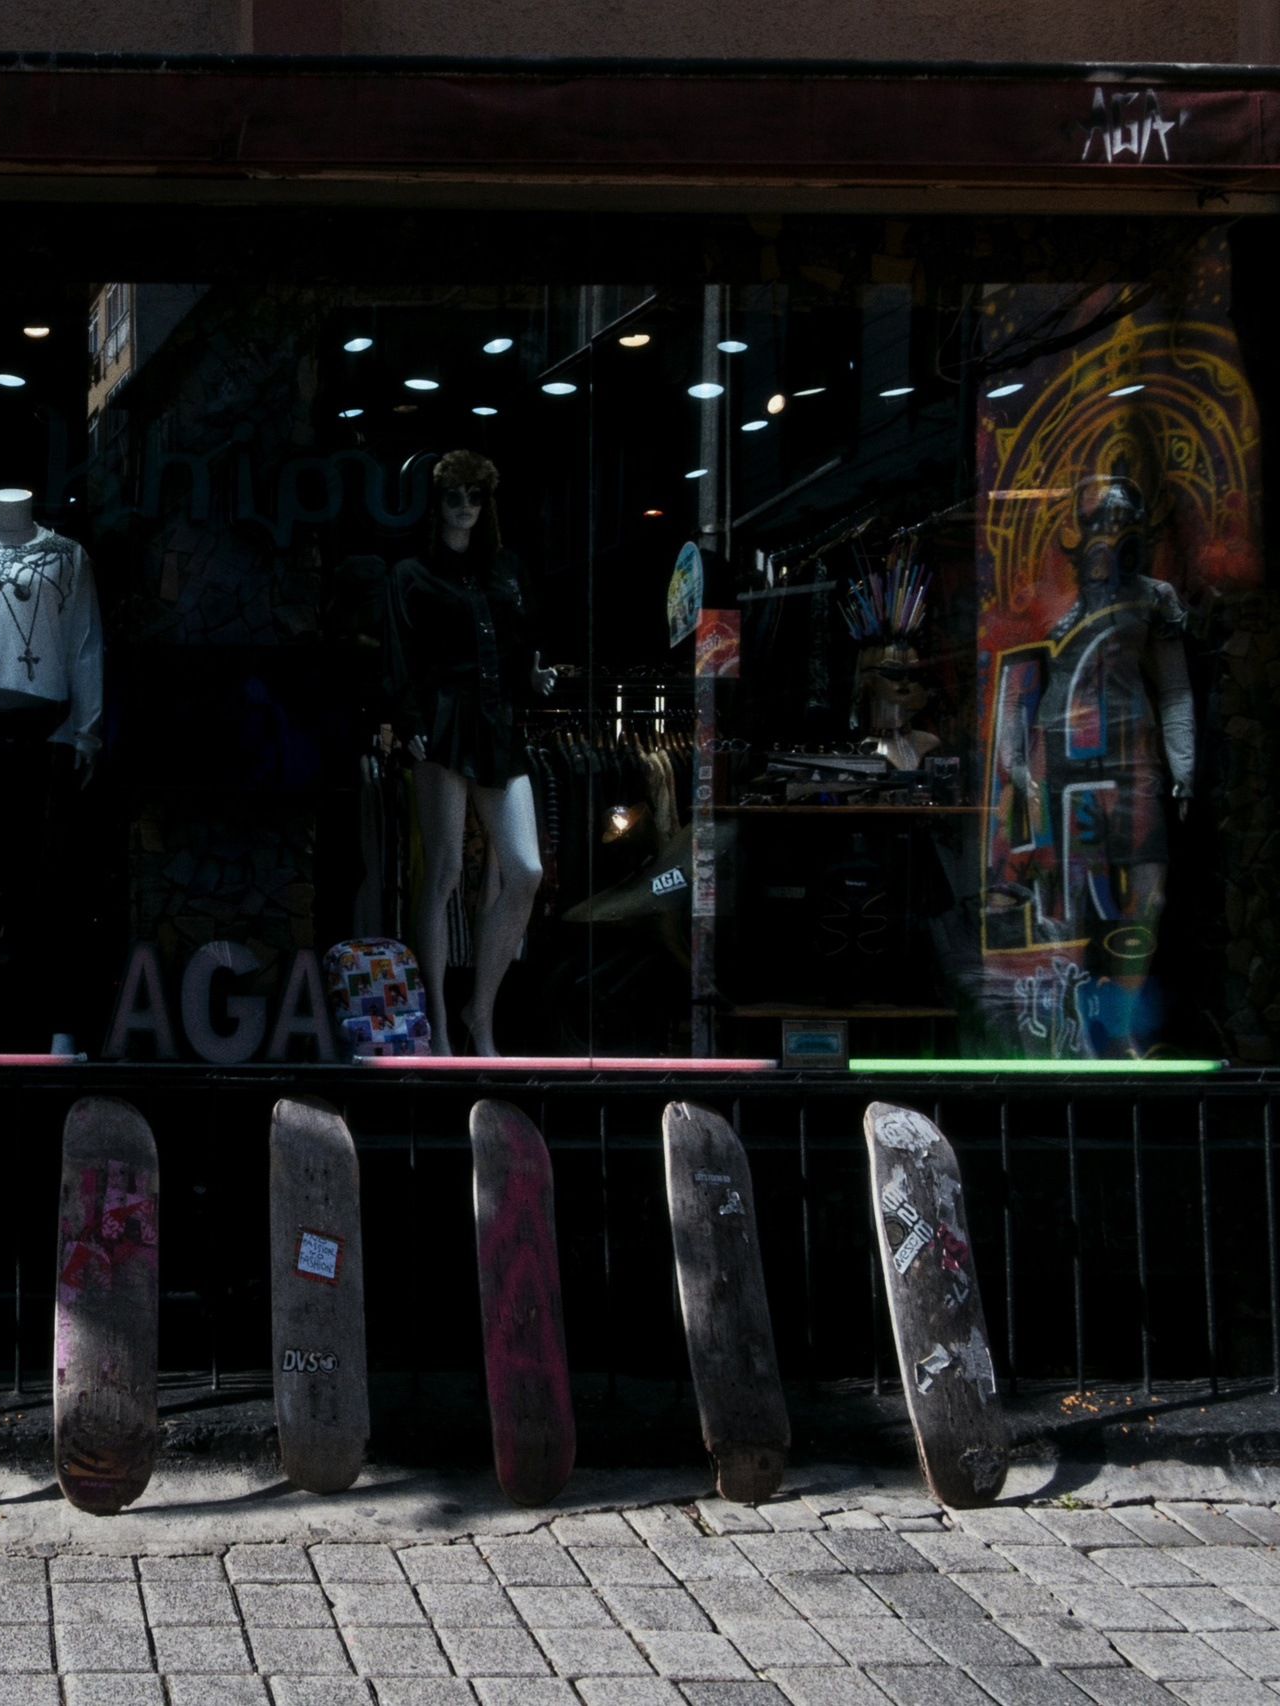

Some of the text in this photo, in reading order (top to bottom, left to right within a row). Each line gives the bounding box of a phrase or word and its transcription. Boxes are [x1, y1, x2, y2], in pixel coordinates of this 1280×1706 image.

[652, 869, 686, 892] AGA
[101, 940, 340, 1064] AGA
[282, 1349, 319, 1373] DVS
